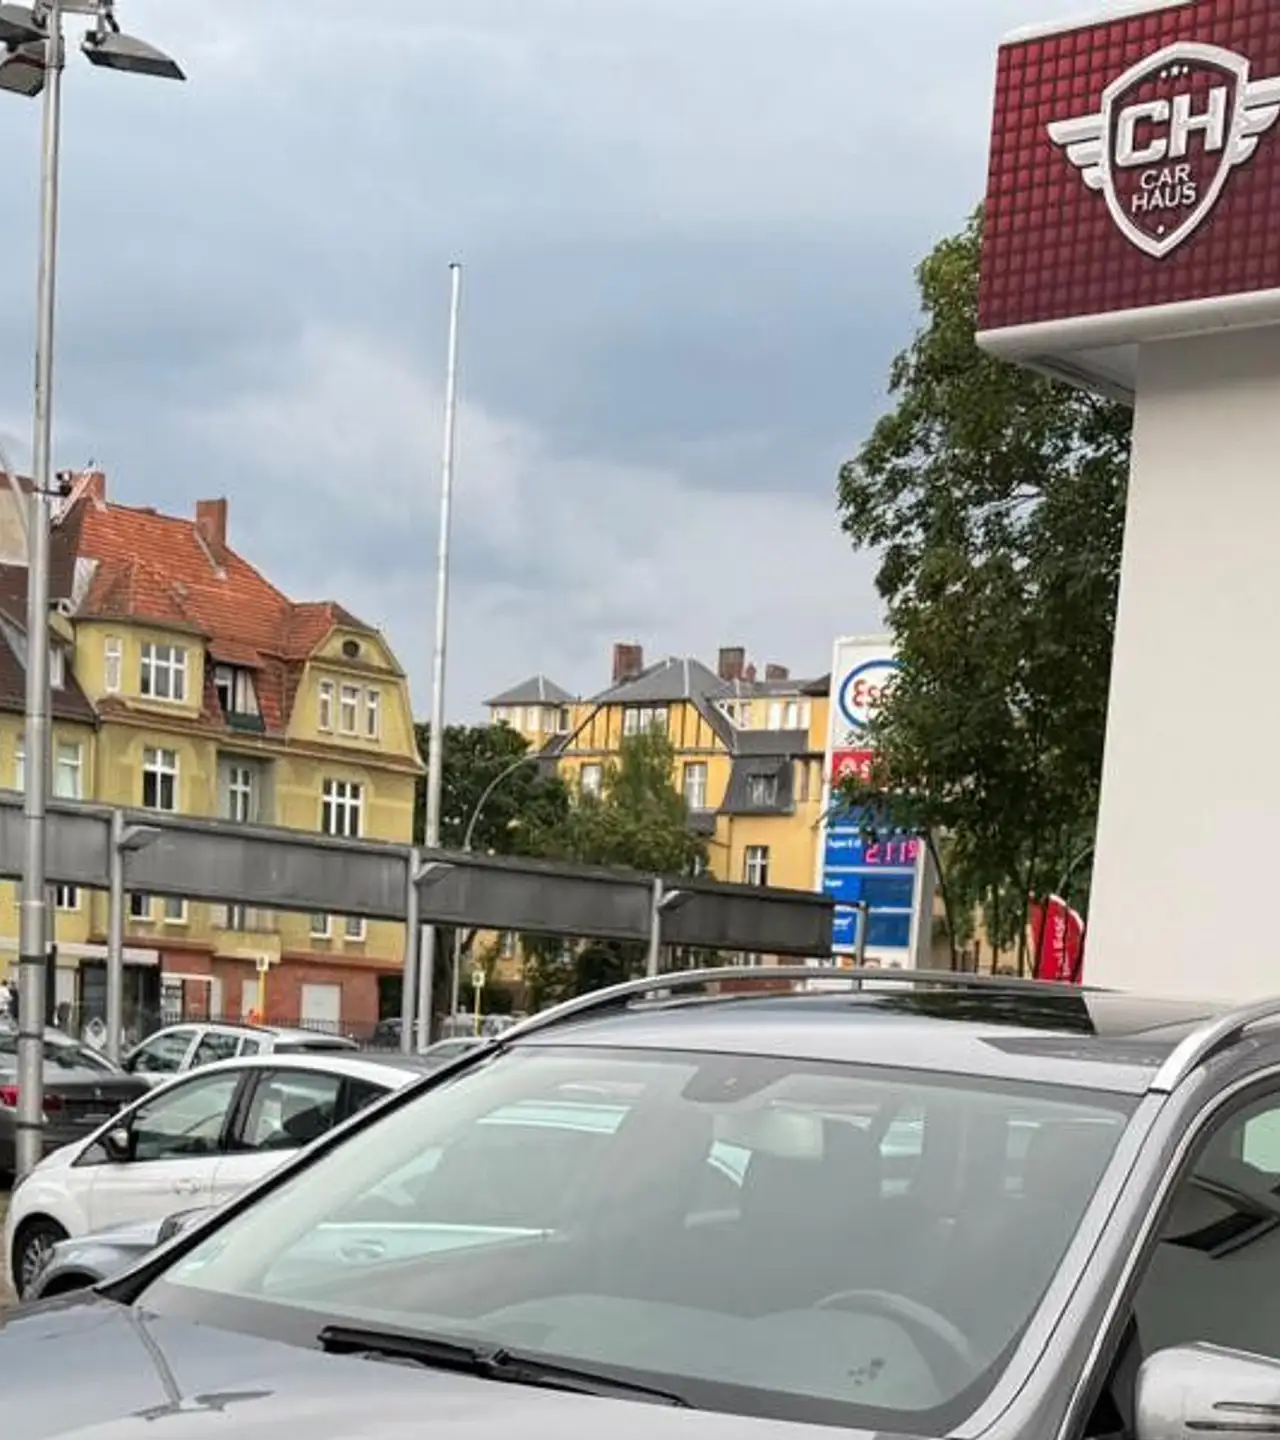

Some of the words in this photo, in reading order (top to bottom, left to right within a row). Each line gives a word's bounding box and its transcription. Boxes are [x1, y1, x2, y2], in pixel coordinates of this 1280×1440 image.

[1116, 86, 1227, 167] CH
[1140, 164, 1191, 189] CAR
[1131, 183, 1197, 213] HAUS
